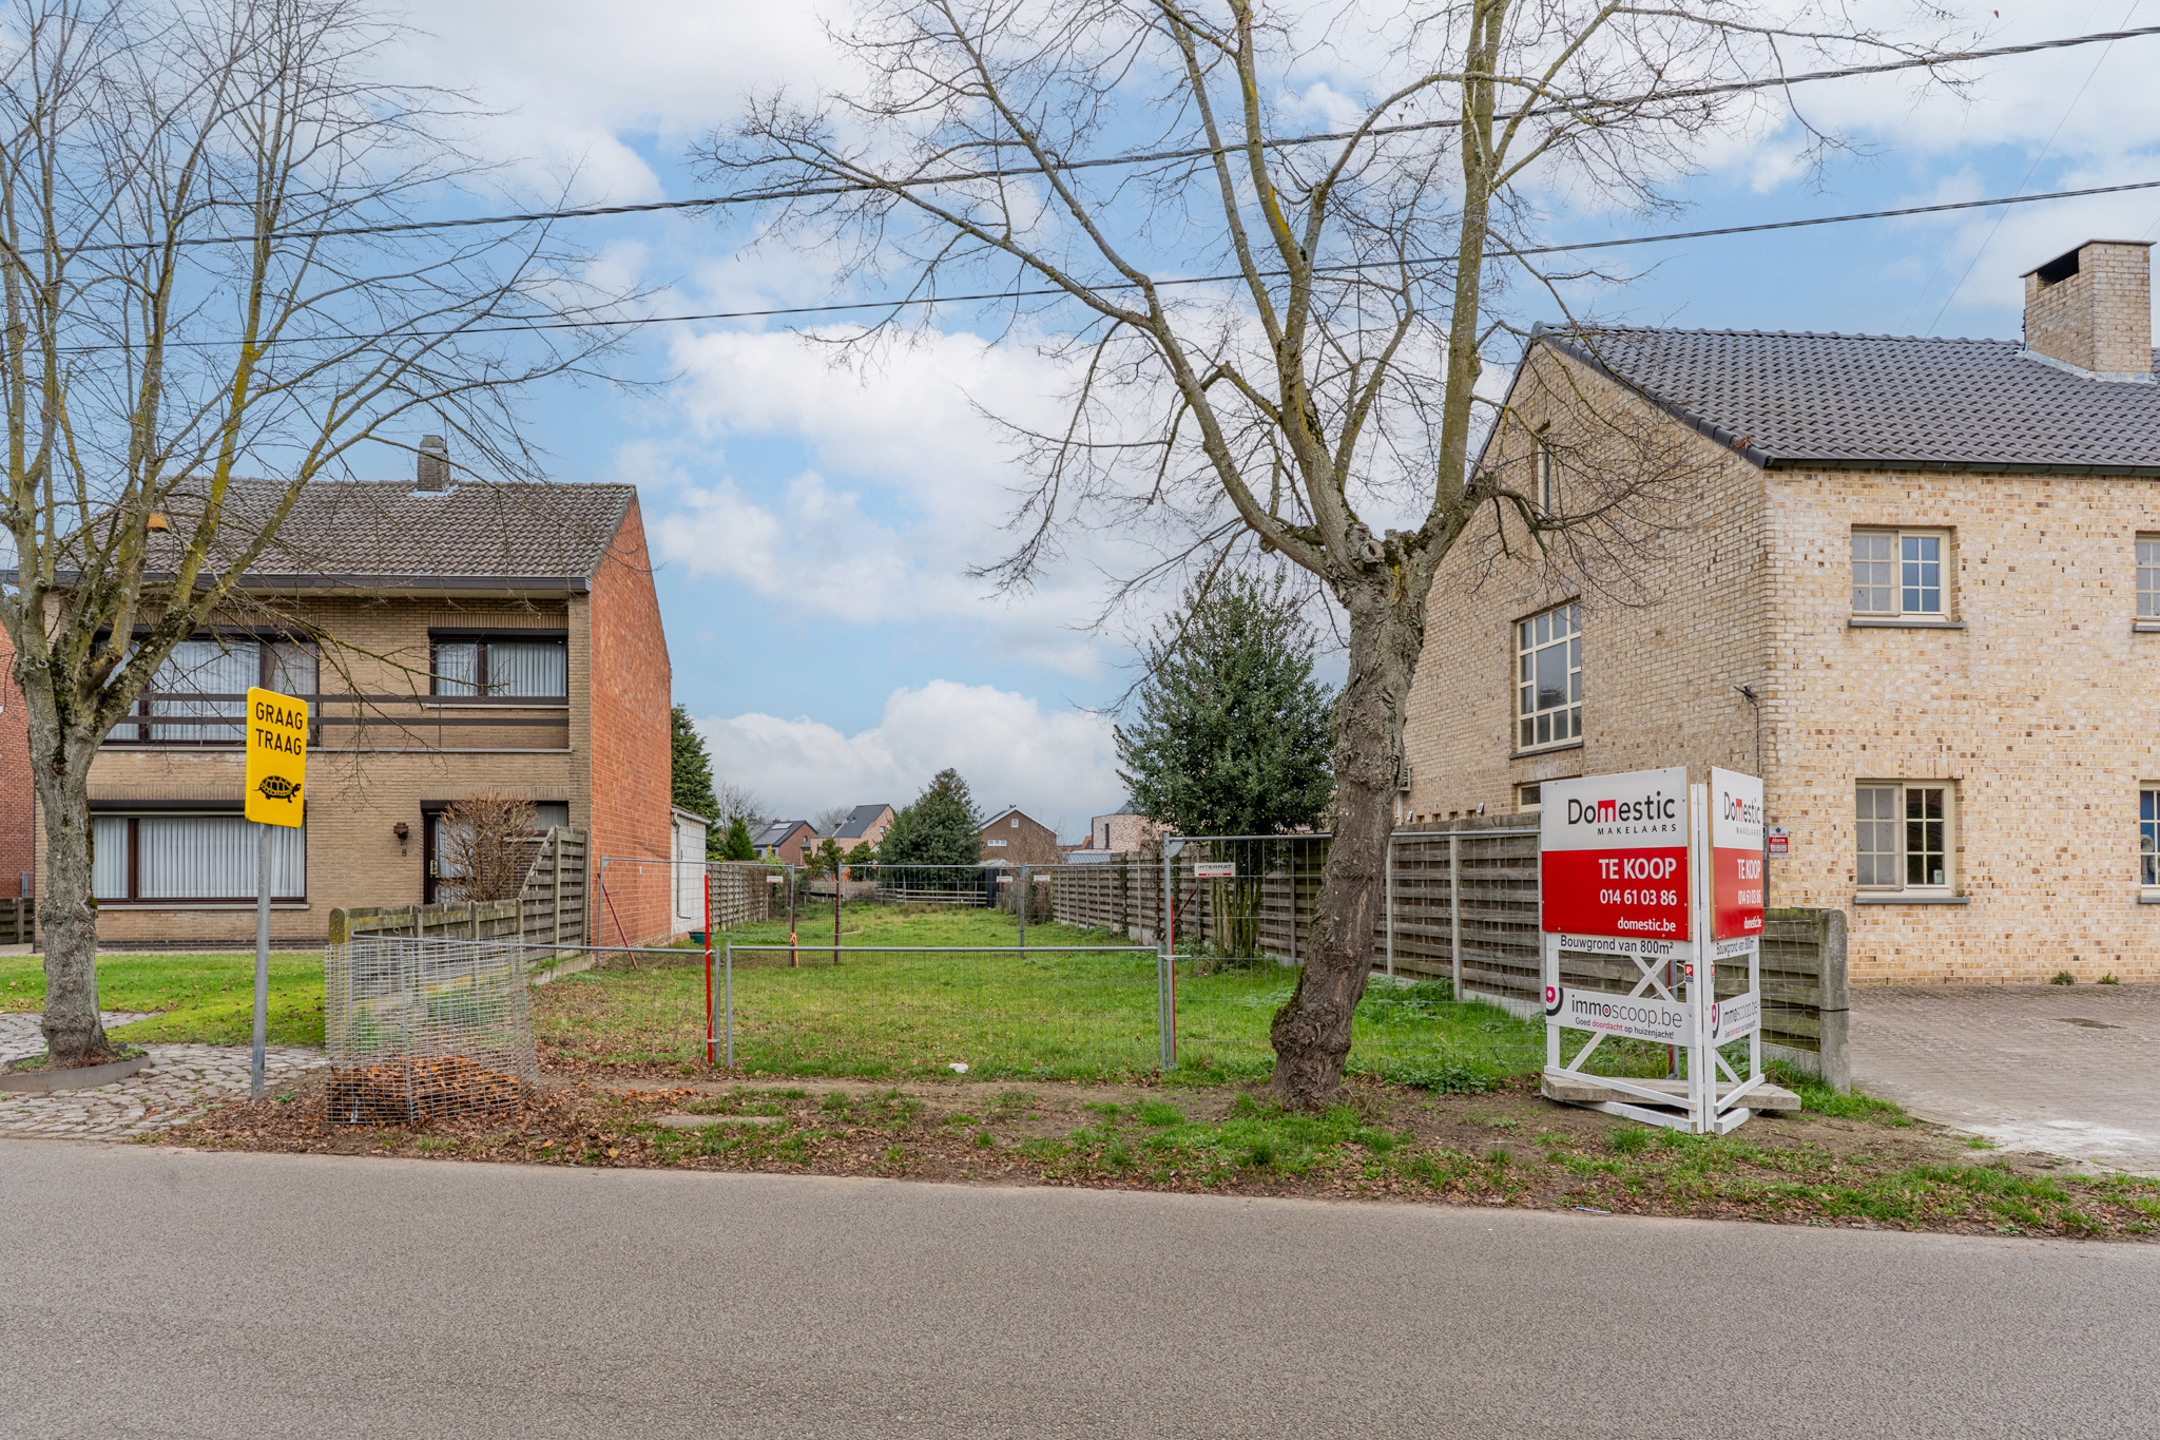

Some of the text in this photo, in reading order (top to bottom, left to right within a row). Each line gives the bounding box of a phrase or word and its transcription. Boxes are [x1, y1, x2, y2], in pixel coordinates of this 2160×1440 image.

[256, 702, 303, 730] GRAAG
[255, 728, 302, 755] TRAAG
[1568, 791, 1675, 825] Domestic
[1724, 791, 1760, 825] Domestic
[1597, 824, 1677, 835] MAKELAARS
[1598, 857, 1677, 879] TE KOOP
[1737, 859, 1761, 880] TE KOOP
[1600, 889, 1677, 906] 014 61 03 86
[1617, 916, 1676, 932] domestic.be
[1560, 934, 1615, 951] Bouwgrond
[1618, 941, 1637, 952] van
[1571, 994, 1682, 1028] immoscoop.be
[1575, 1016, 1591, 1027] Goed
[1592, 1020, 1623, 1032] doordacht
[1634, 1027, 1674, 1040] huizenjacht!
